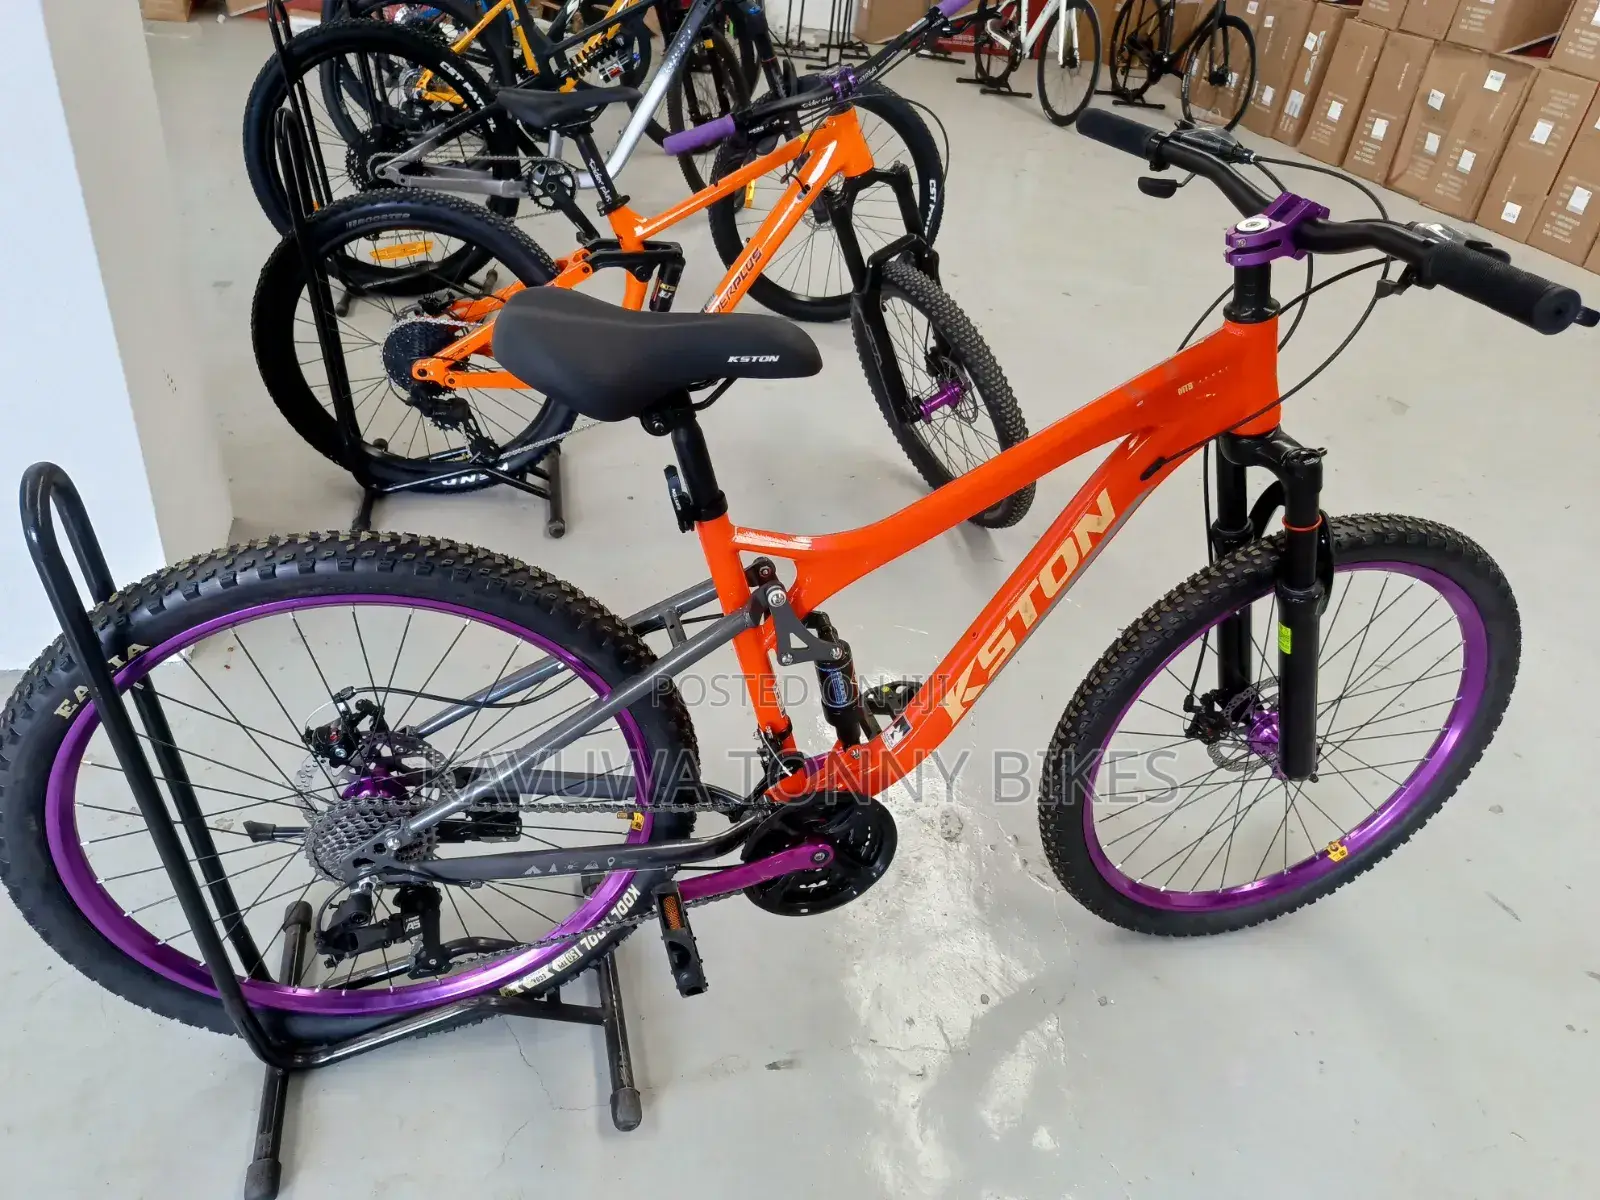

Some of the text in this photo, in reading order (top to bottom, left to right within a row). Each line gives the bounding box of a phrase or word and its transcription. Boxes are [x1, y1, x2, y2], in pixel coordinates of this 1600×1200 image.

[727, 355, 780, 363] KSTON
[943, 487, 1117, 725] KSTON
[610, 883, 641, 920] KOOL
